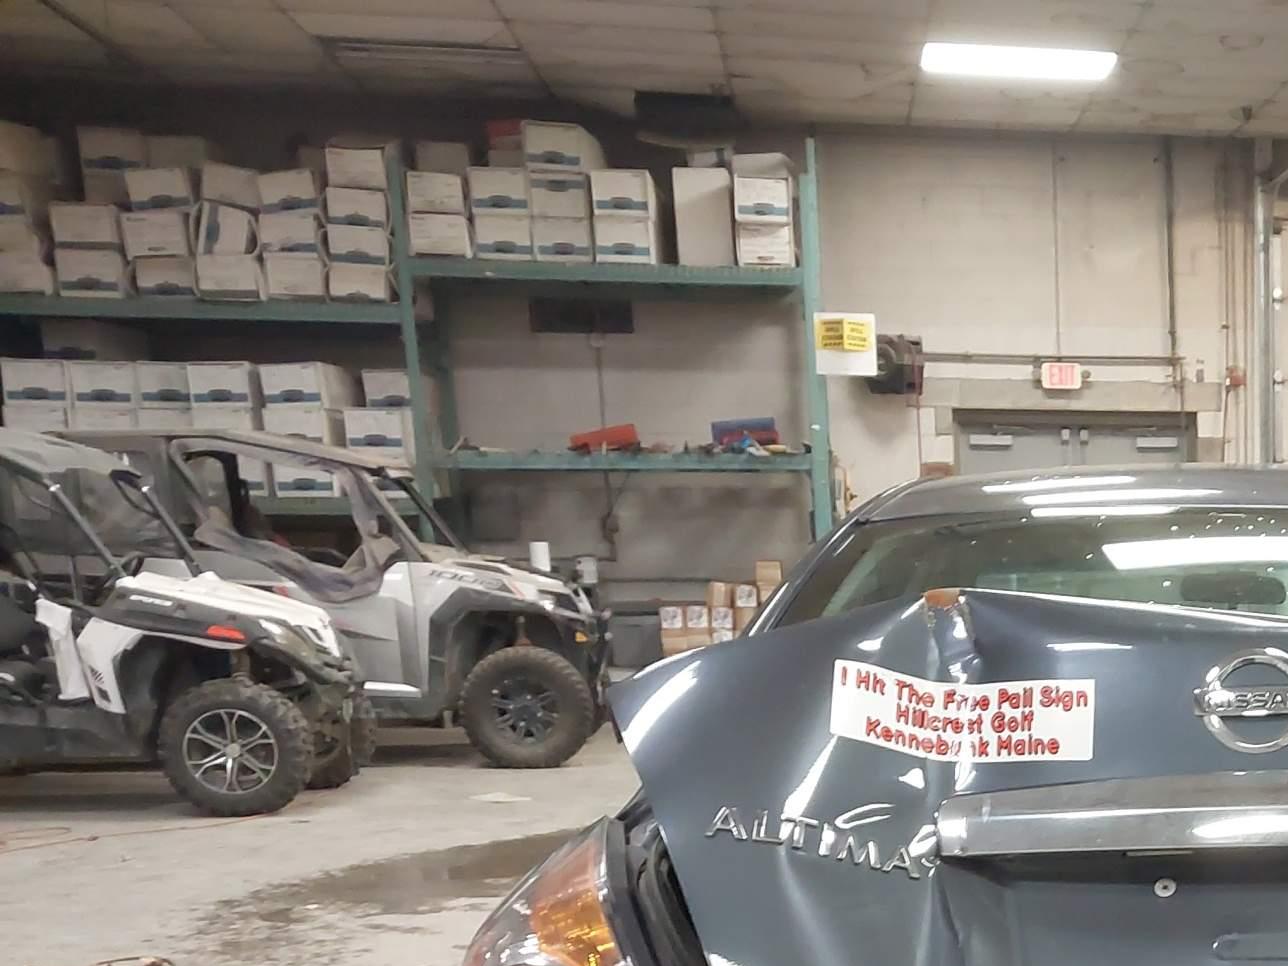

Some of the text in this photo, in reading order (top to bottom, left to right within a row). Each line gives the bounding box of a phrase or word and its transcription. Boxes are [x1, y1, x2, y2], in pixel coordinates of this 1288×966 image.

[1048, 364, 1076, 386] EXIT
[840, 666, 848, 686] I
[856, 668, 887, 696] Hit
[895, 678, 935, 708] The
[997, 688, 1034, 711] Pail
[1039, 685, 1088, 712] Sign
[895, 702, 1035, 735] Hillcrest Golf
[996, 734, 1060, 758] Maine
[704, 806, 921, 879] ALTIMA
